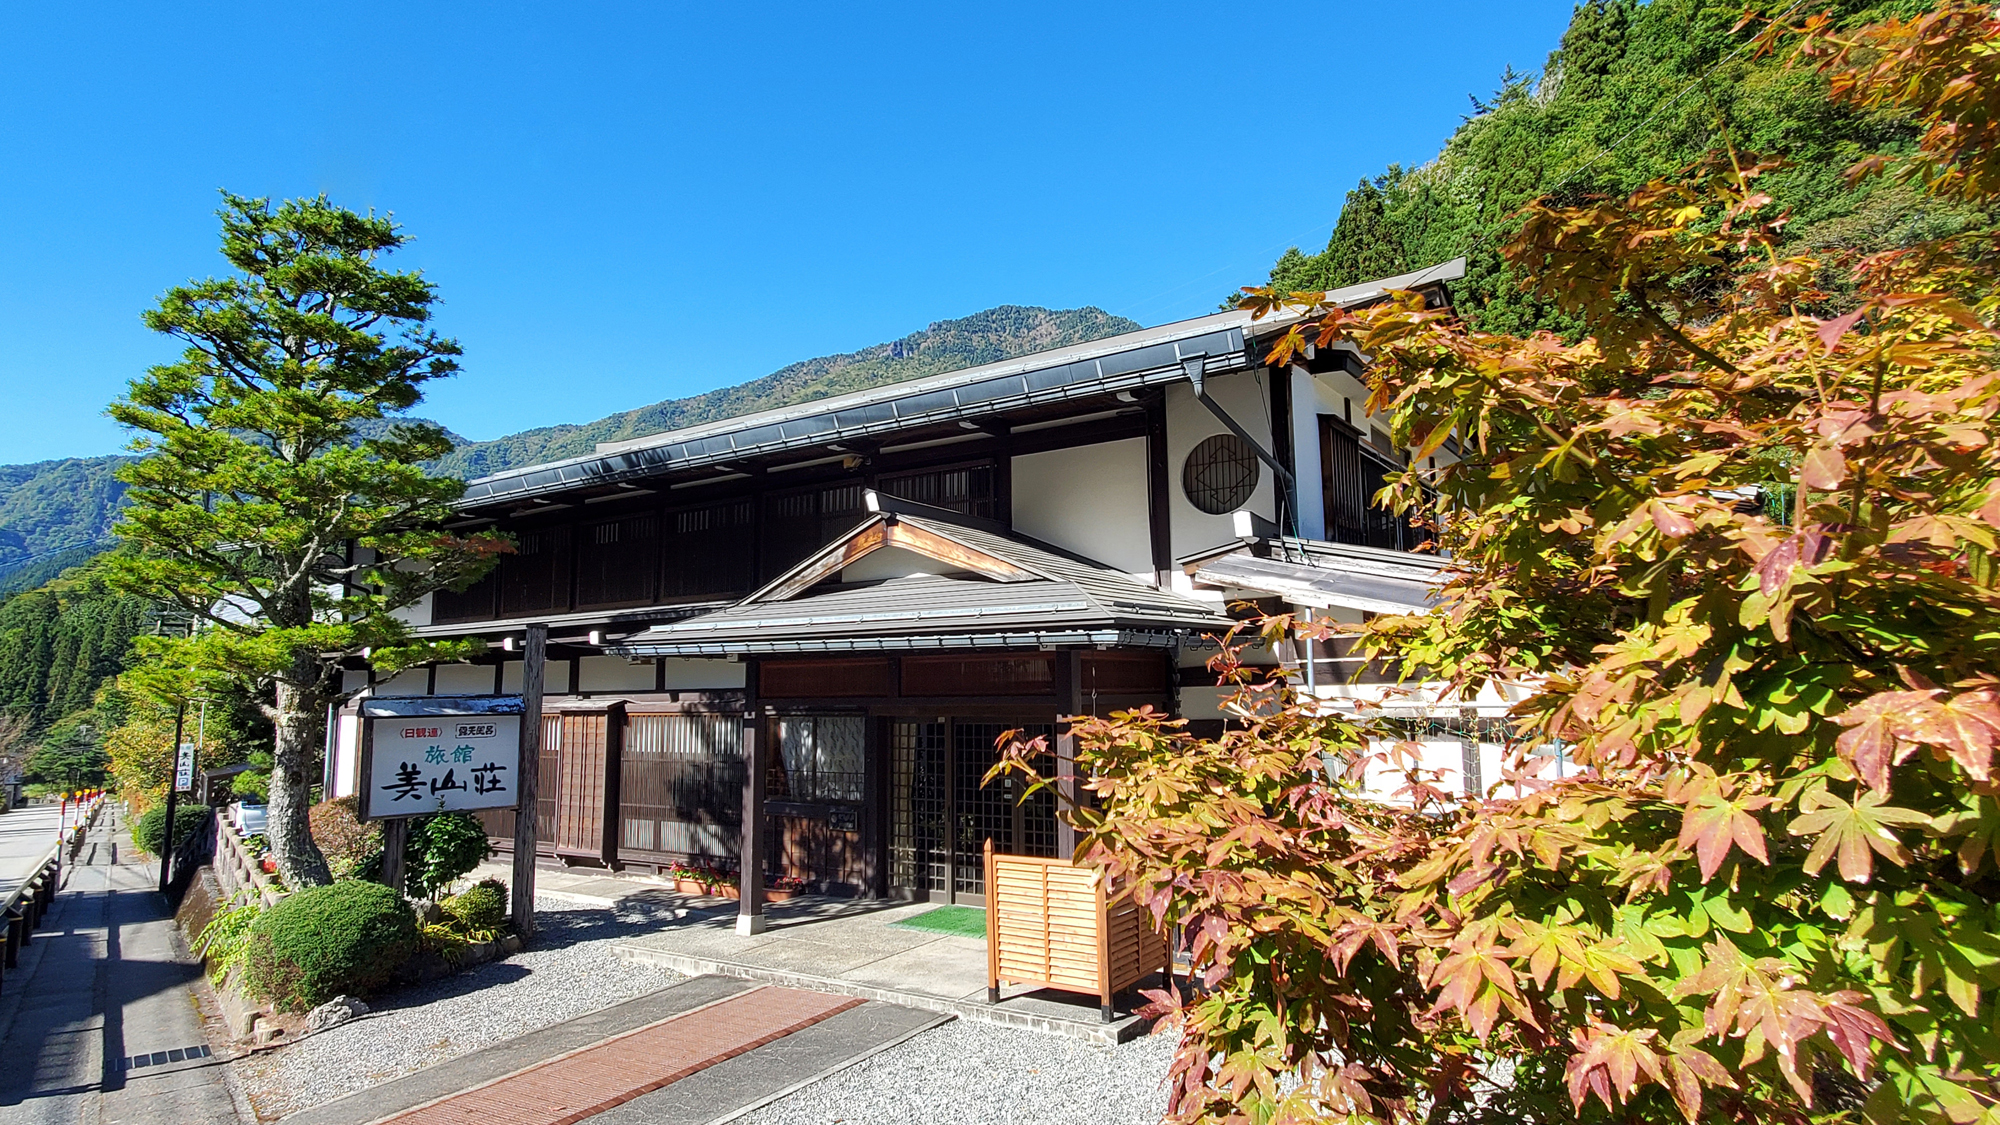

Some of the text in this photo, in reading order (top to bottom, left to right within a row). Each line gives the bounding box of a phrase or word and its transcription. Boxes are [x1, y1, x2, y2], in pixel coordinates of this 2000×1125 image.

[458, 725, 494, 736] 露天風呂
[178, 751, 191, 777] 美山荘
[424, 744, 475, 765] 旅館
[381, 761, 507, 801] 美山荘
